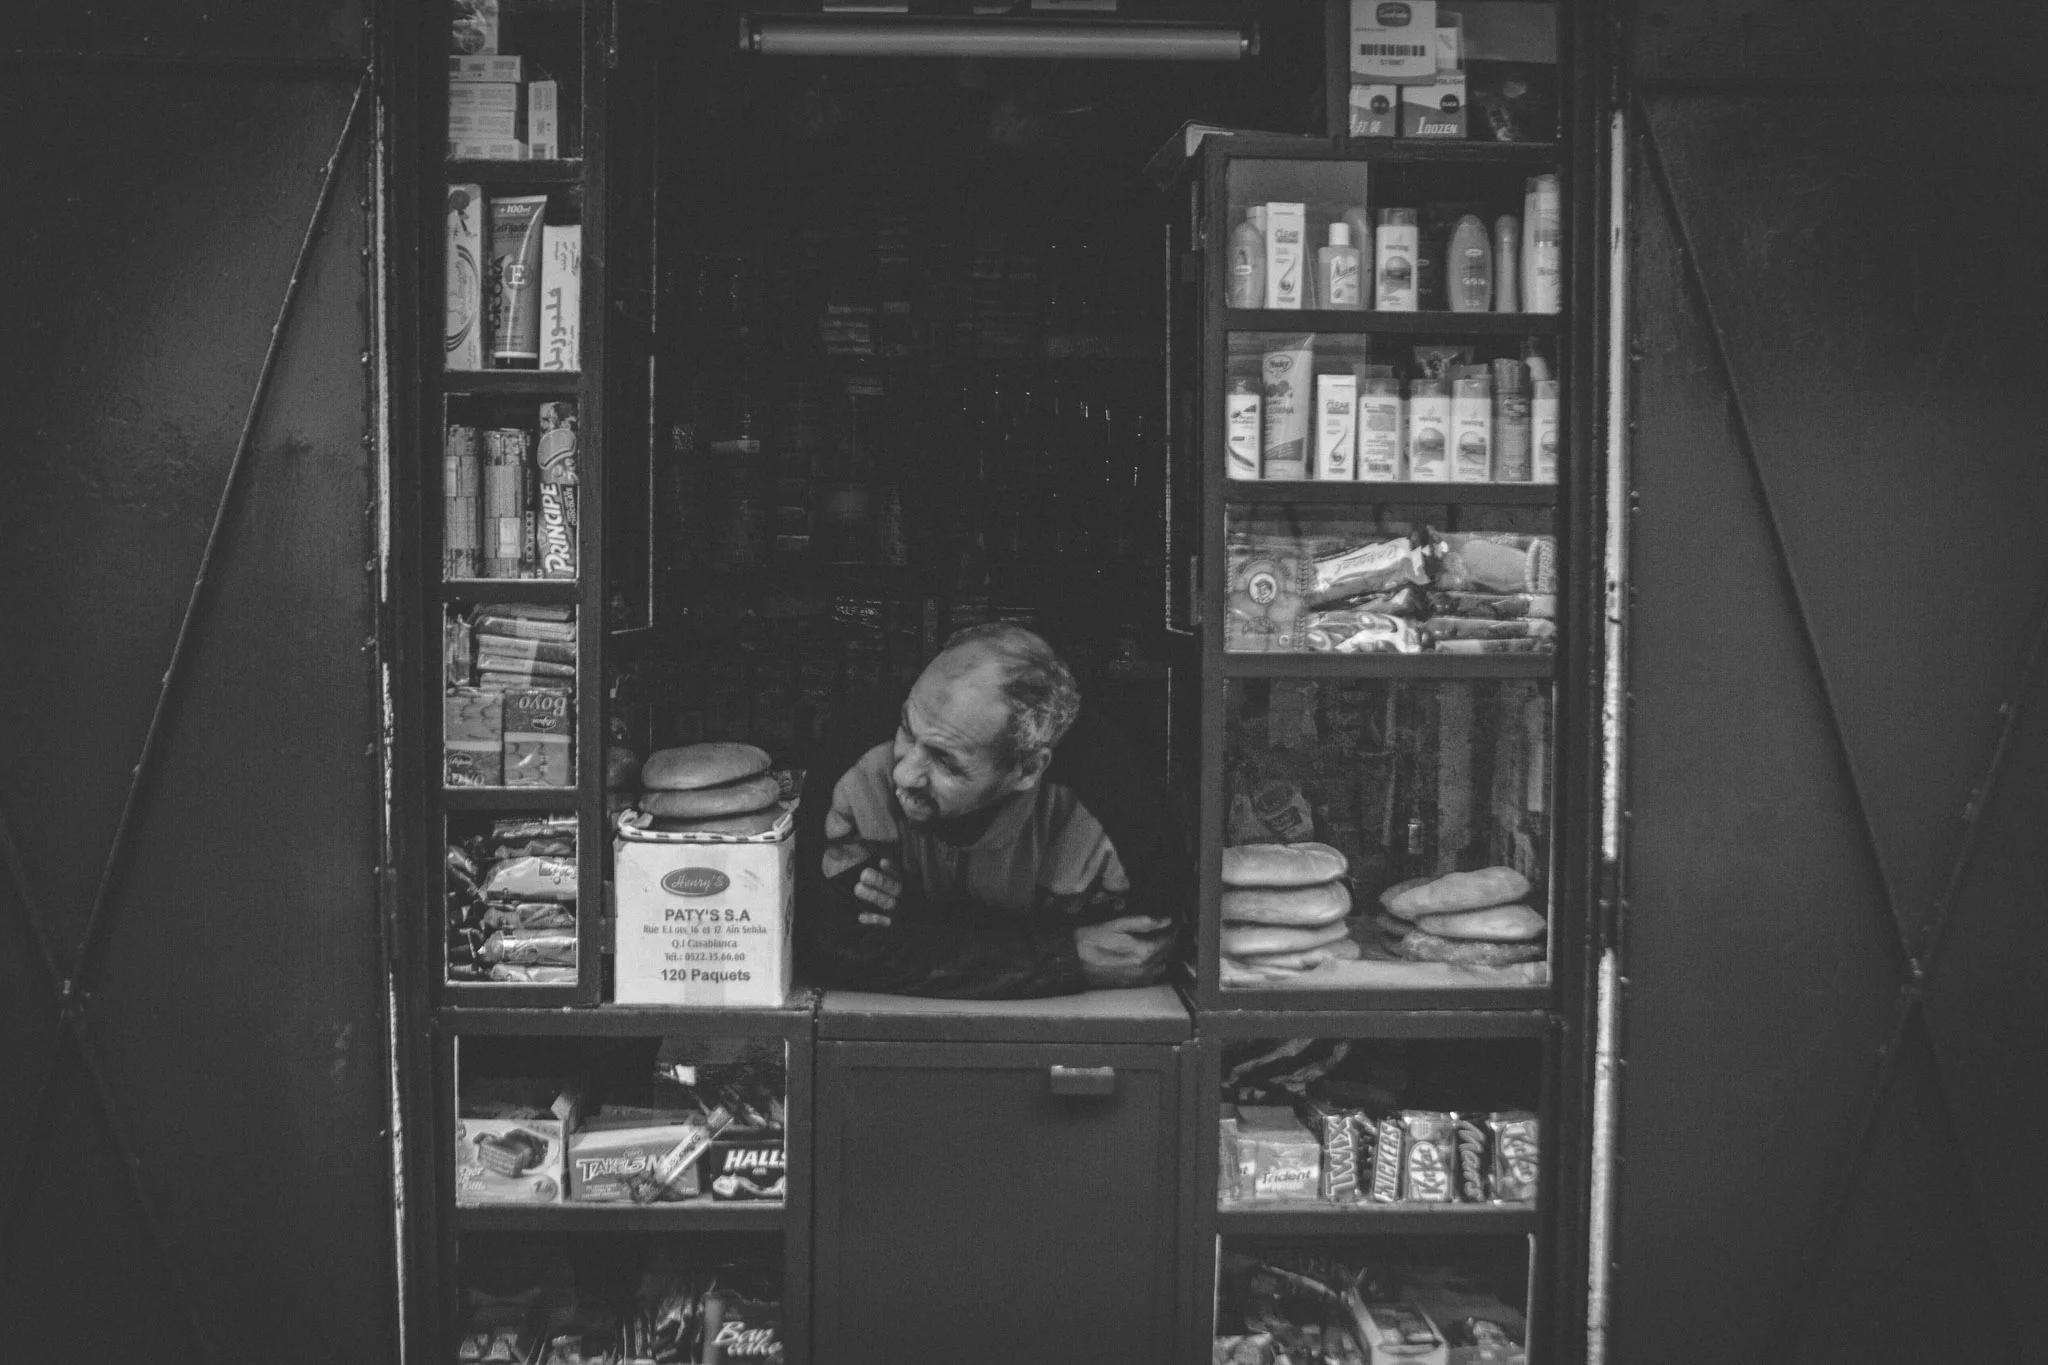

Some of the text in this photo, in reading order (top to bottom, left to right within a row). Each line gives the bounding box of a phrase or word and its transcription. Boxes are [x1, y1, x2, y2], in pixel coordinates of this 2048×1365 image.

[540, 482, 575, 573] PRINCIPE
[664, 908, 751, 922] PATY'S S.A
[687, 939, 738, 949] Casablanca
[660, 968, 751, 984] 120 Paquets
[1324, 1115, 1356, 1197] TWIX
[1458, 1119, 1485, 1201] Mars
[1262, 1169, 1311, 1184] Trident
